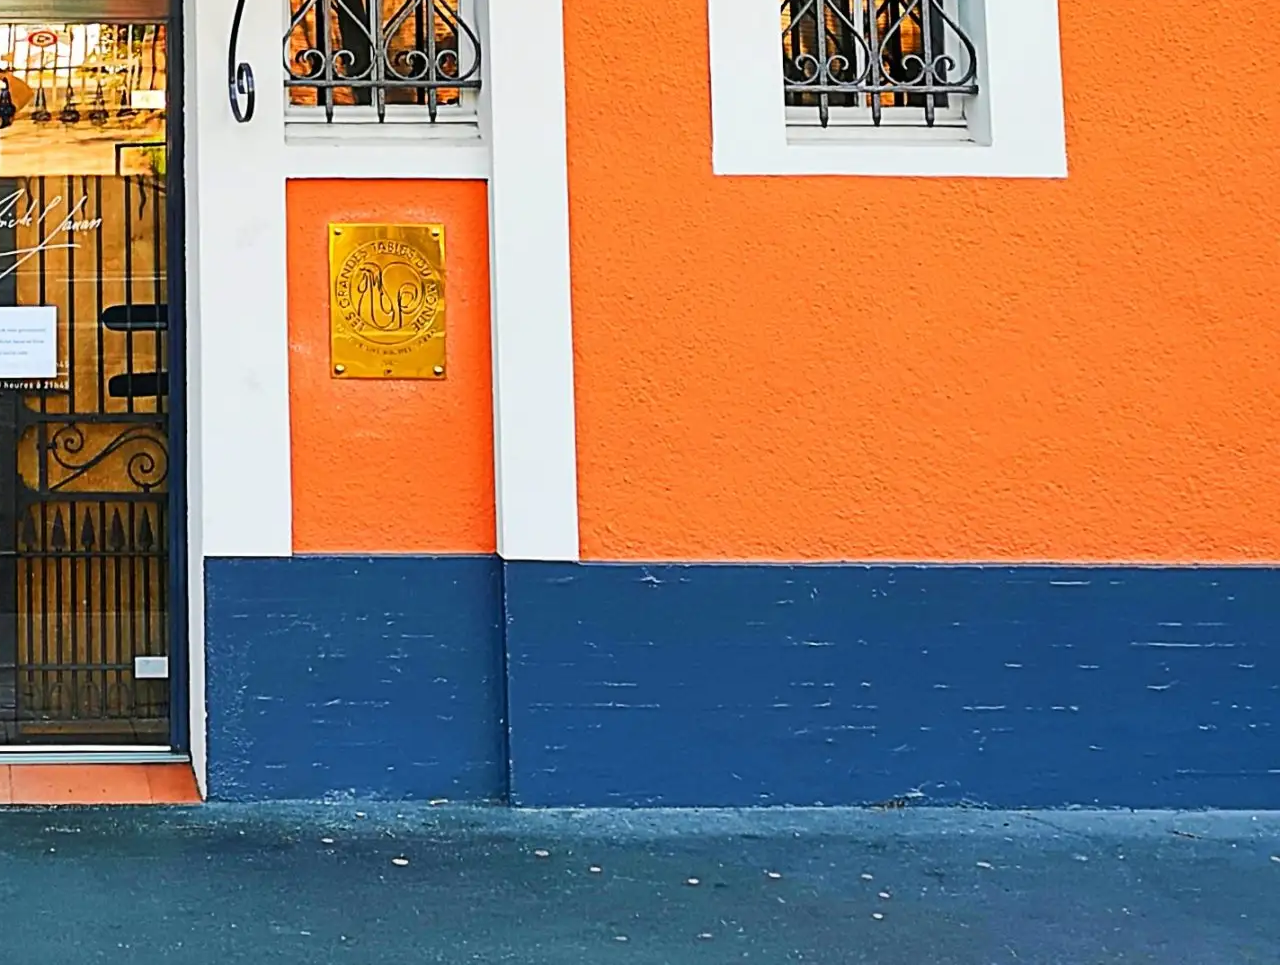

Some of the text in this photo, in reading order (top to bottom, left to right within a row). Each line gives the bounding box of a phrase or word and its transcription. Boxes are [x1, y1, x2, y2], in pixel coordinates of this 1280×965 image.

[337, 241, 438, 332] LES GRANDES TABLES DU MONDE
[4, 381, 33, 389] heures
[44, 381, 70, 390] 21h45
